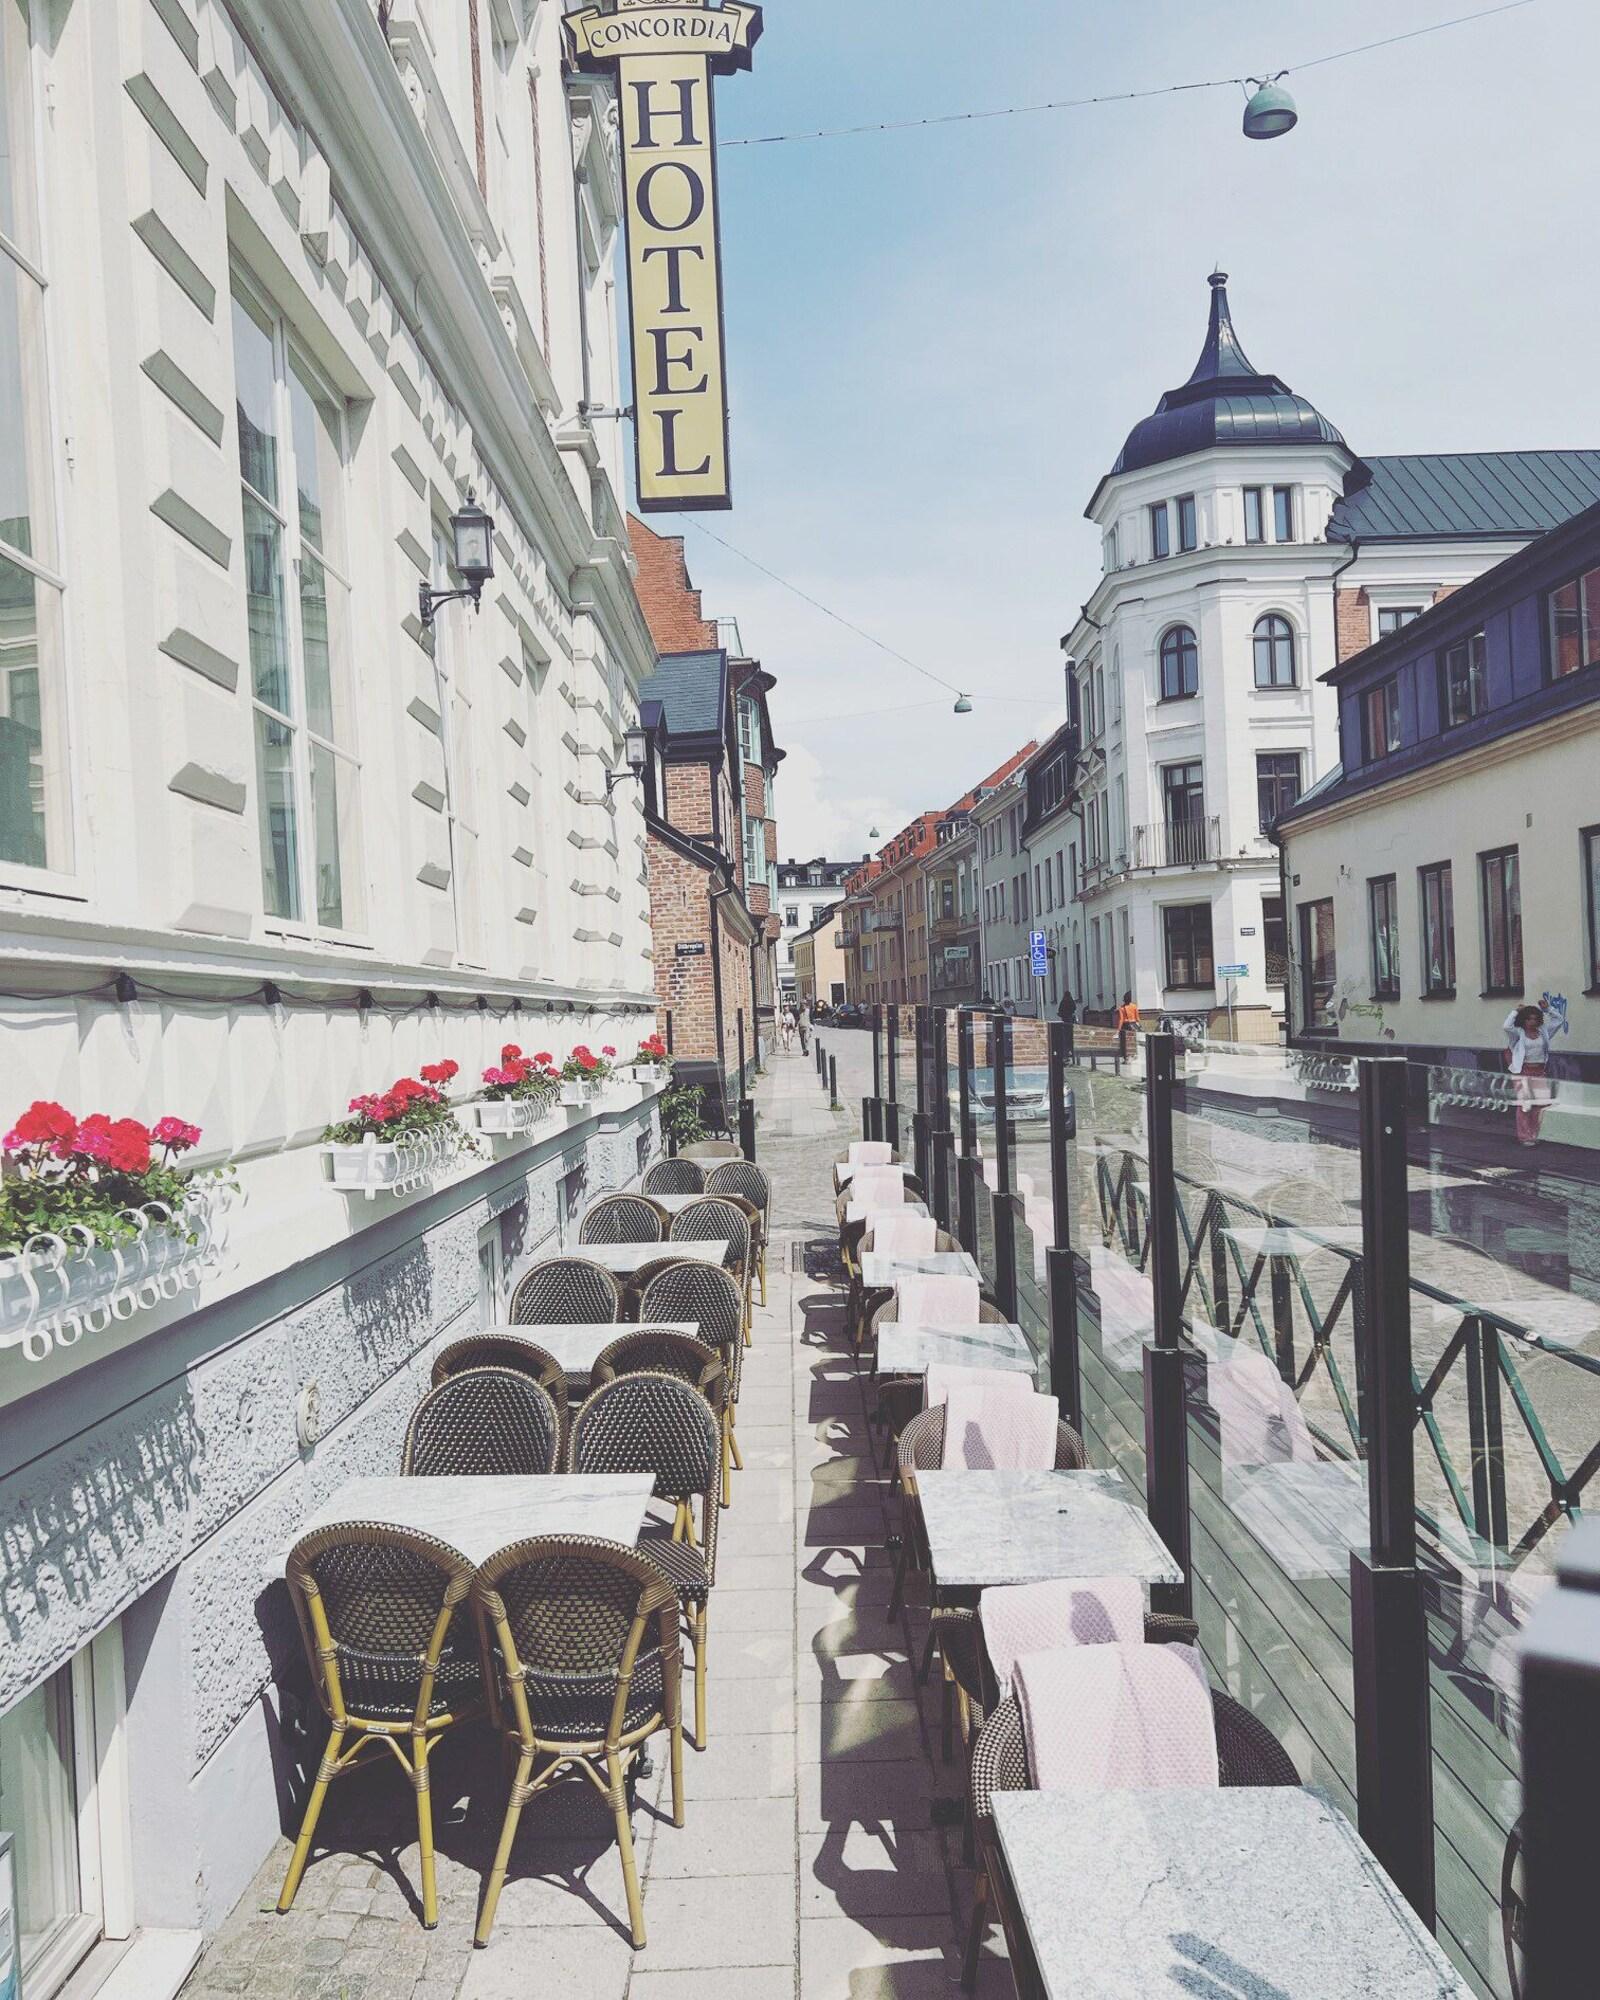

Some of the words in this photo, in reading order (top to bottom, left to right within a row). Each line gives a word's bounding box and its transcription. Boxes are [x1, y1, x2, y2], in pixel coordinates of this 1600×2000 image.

[591, 18, 731, 48] CONCORDIA
[628, 78, 711, 476] HOTEL
[1034, 932, 1043, 945] P
